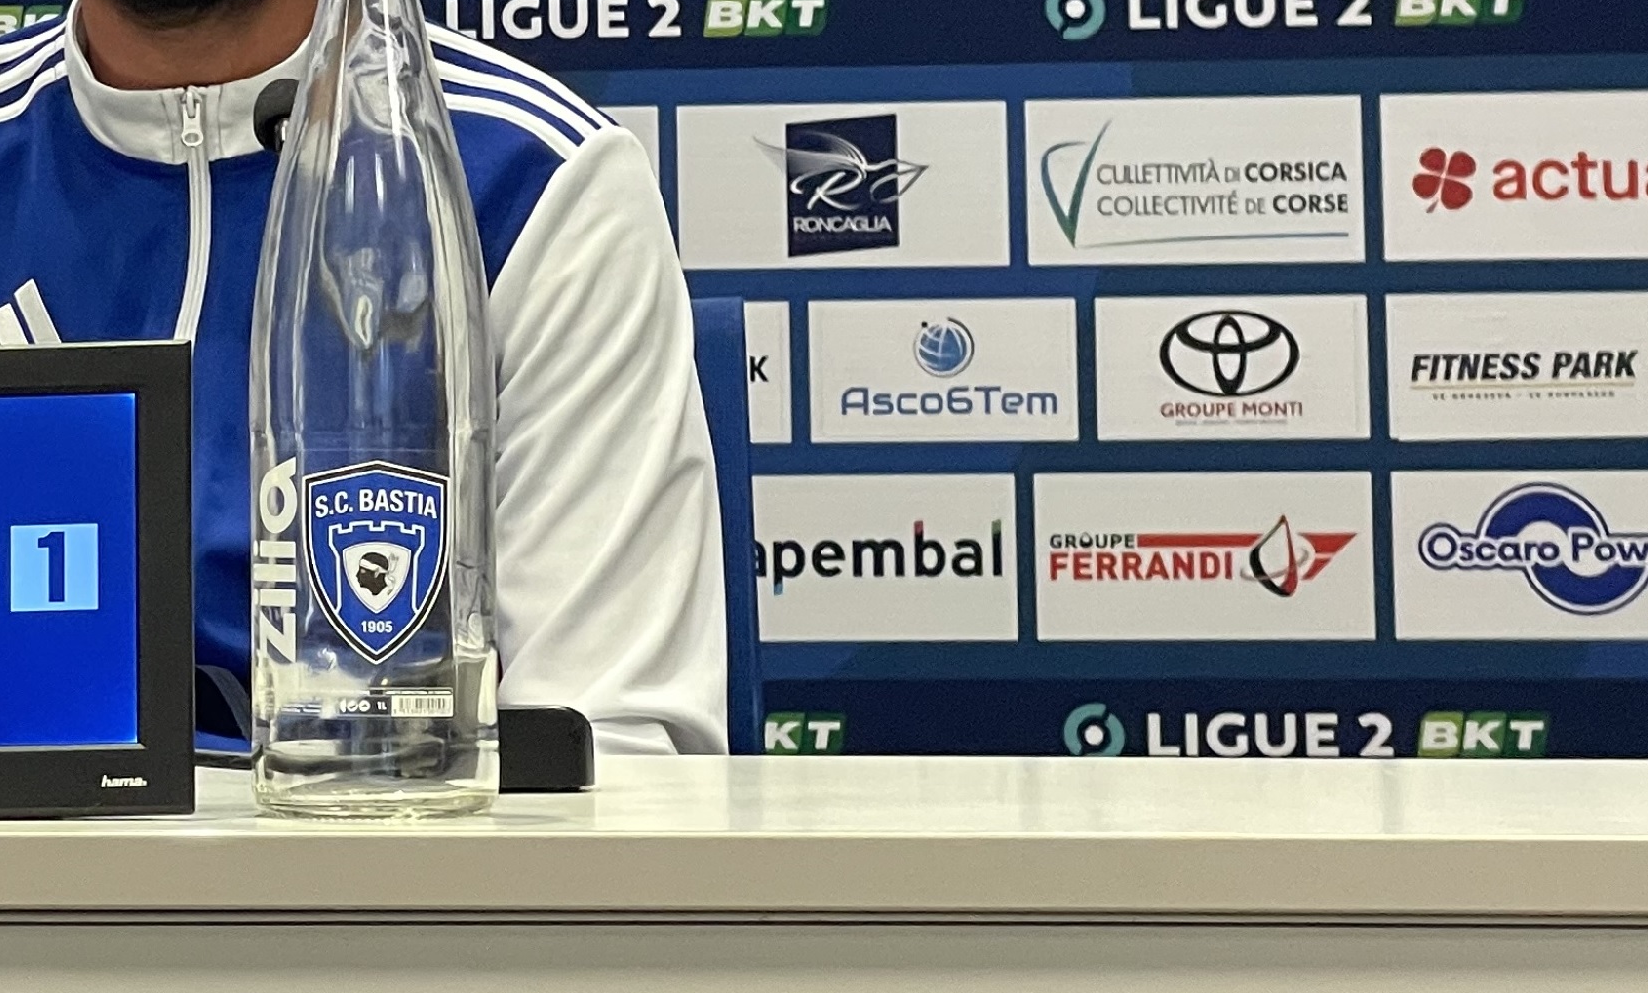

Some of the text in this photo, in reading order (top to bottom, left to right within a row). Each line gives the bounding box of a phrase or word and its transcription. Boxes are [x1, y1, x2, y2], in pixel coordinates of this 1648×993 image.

[706, 0, 825, 29] BKT
[1245, 161, 1348, 183] CORSICA
[1492, 151, 1648, 202] actu
[1097, 191, 1349, 216] COLLECTIVITÉ DE CORSE
[794, 215, 892, 233] RONCAGLIA
[1411, 350, 1638, 382] FITNESS PARK
[841, 385, 1058, 417] Asco6Tem
[1161, 401, 1303, 417] GROUPE MONTI
[315, 489, 438, 519] S.C. BASTIA
[1049, 533, 1135, 549] GROUPE
[1428, 534, 1560, 561] Oscaro
[1049, 551, 1233, 581] FERRANDI
[361, 621, 393, 633] 1905
[1147, 712, 1544, 757] LIGUE 2 BKT
